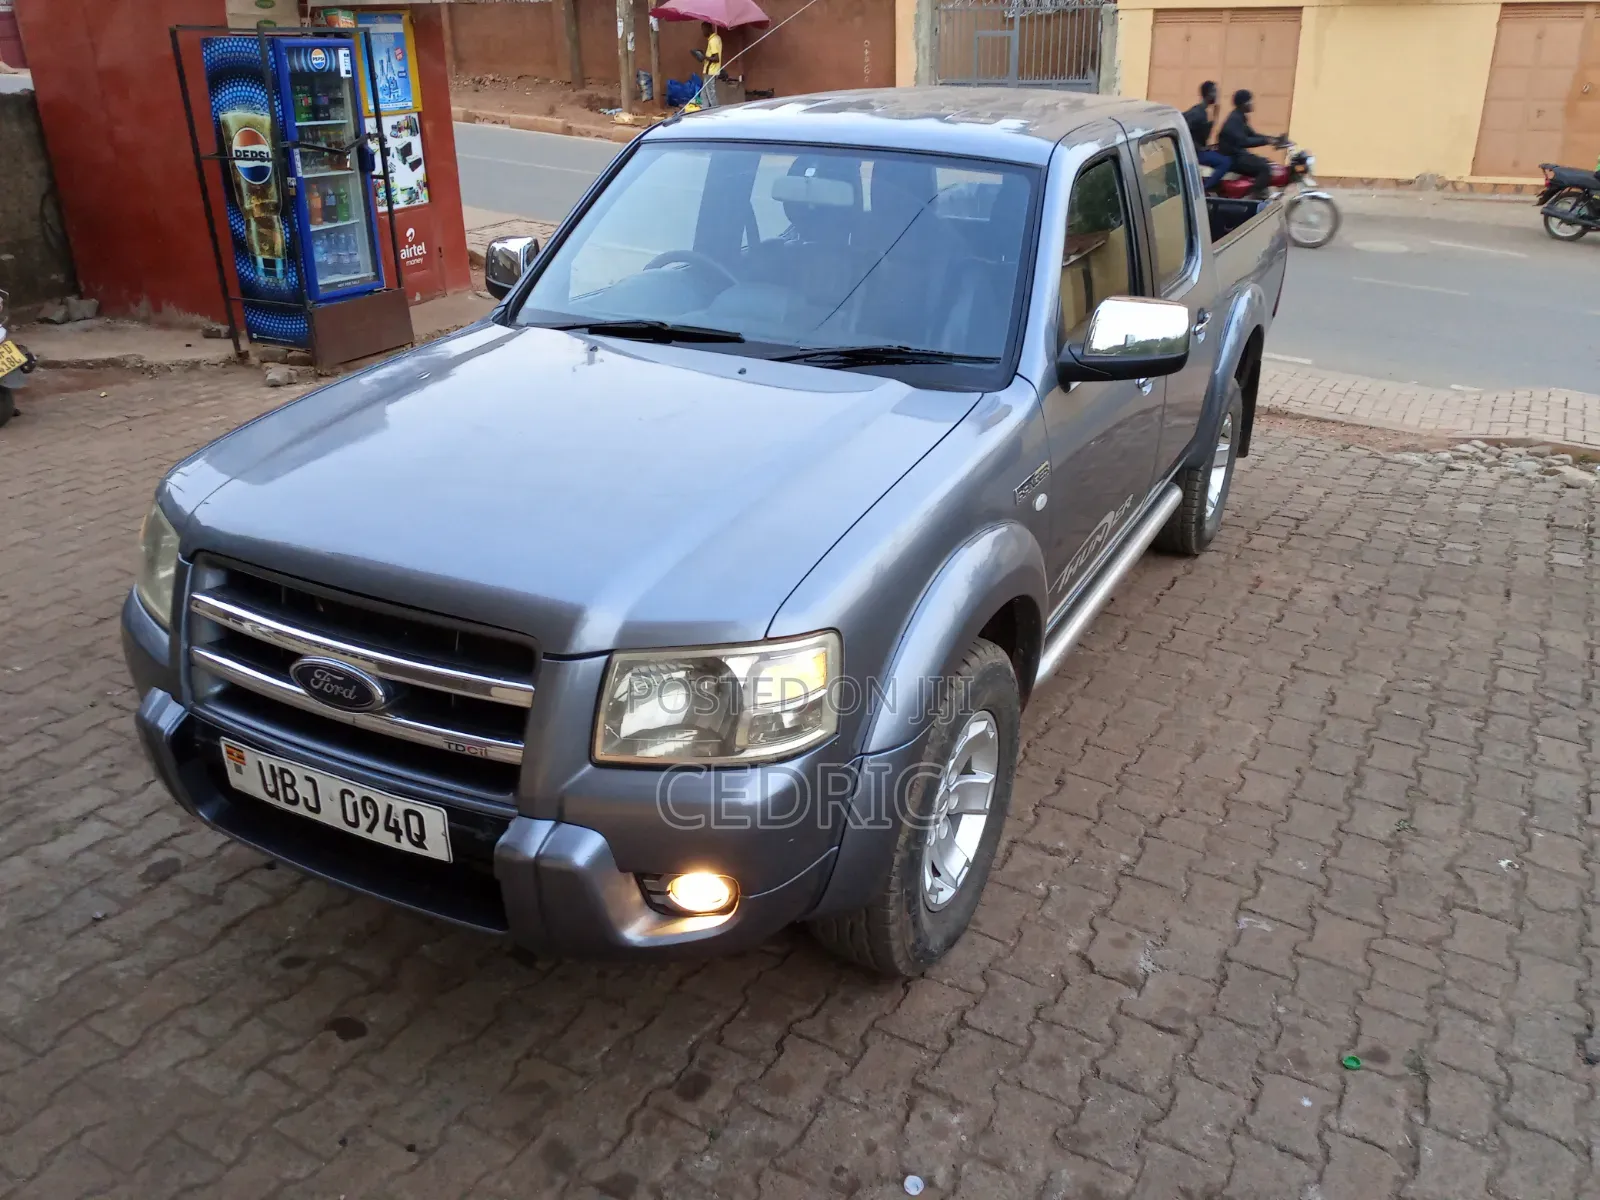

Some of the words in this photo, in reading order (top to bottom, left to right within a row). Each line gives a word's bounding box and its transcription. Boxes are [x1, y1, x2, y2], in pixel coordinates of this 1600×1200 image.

[234, 149, 272, 163] PEPSI
[400, 242, 427, 260] airtel
[405, 257, 424, 267] money
[309, 668, 357, 701] Ford
[257, 760, 322, 815] UBJ
[339, 788, 430, 851] 094Q
